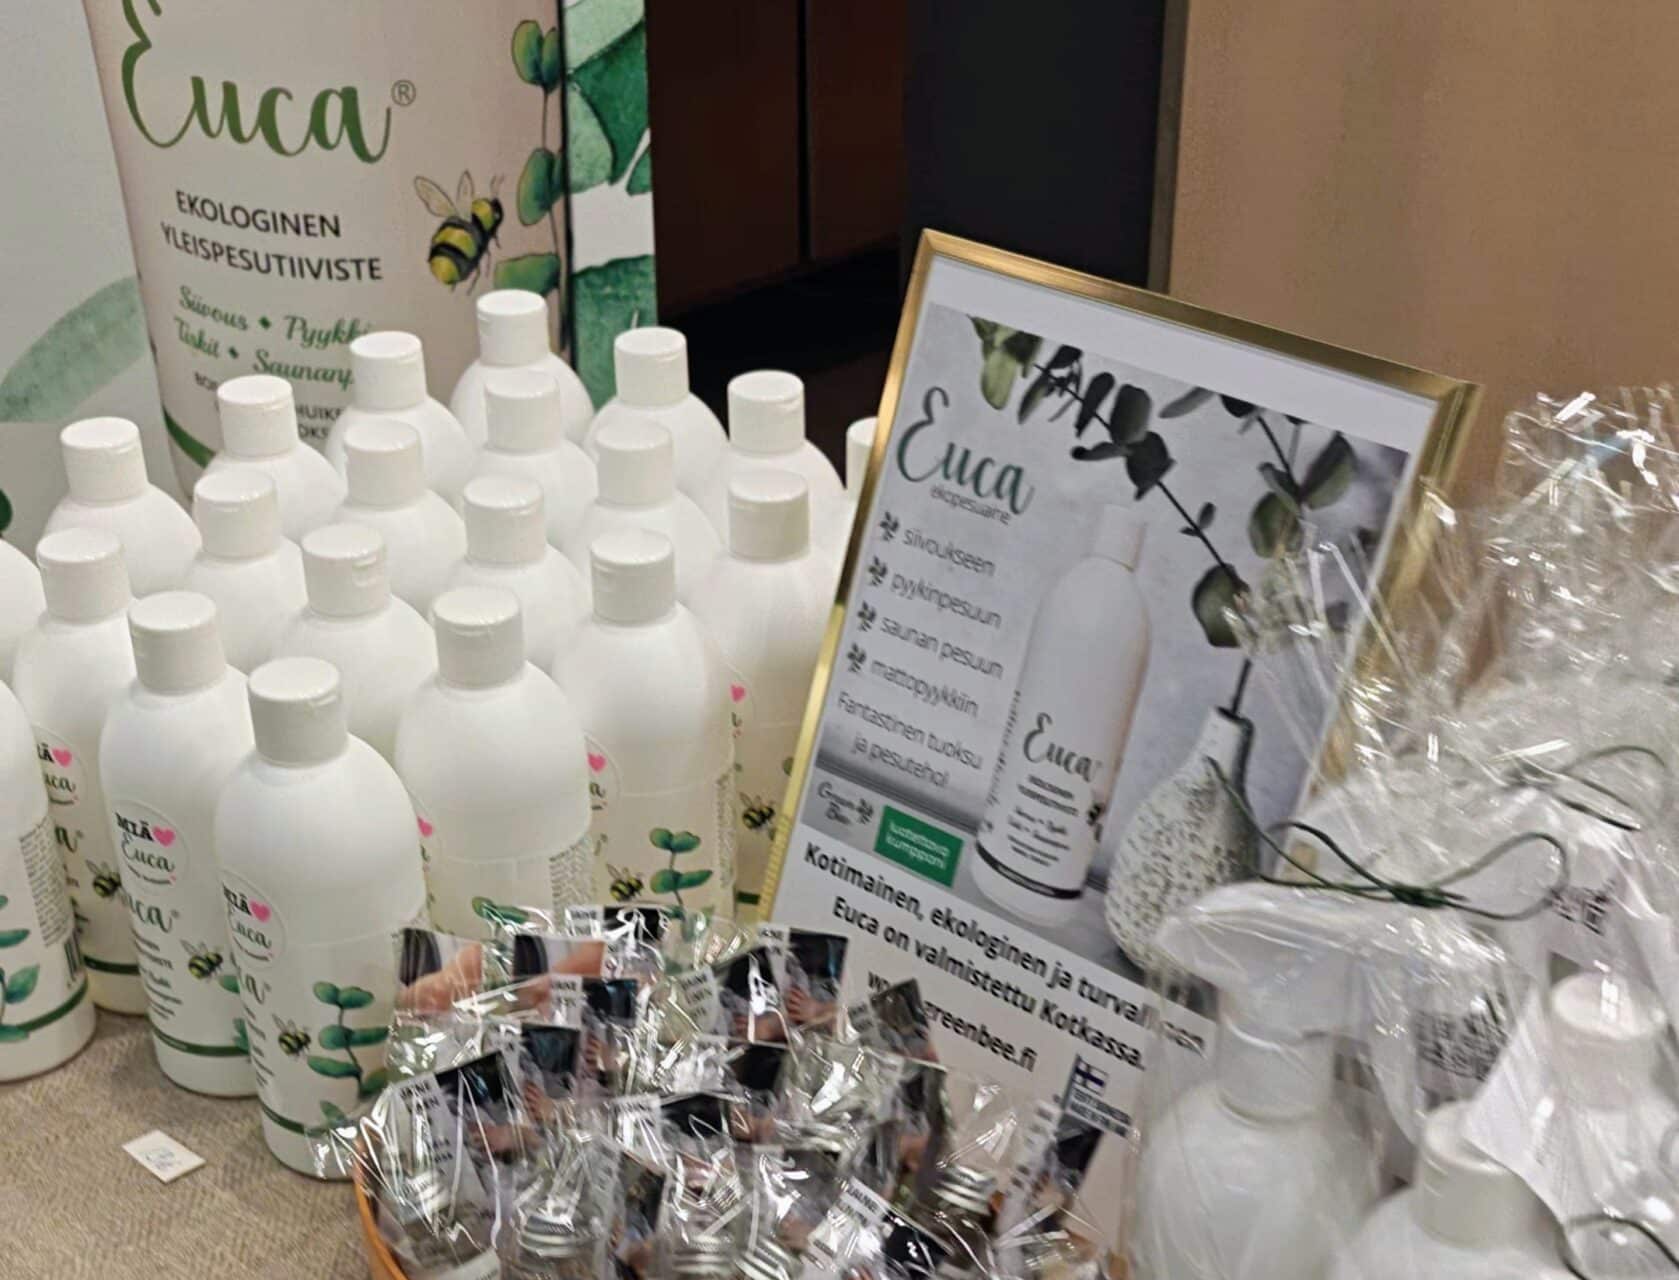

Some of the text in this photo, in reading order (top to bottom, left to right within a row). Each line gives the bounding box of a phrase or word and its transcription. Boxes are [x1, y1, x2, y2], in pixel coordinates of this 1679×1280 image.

[175, 190, 341, 238] EKOLOGINEN
[160, 221, 383, 282] YLEISPESUTIIVISTE
[178, 284, 249, 331] Siivous
[896, 385, 1035, 516] Euca
[903, 528, 995, 578] siivoukseen
[891, 572, 1002, 630] pyykinpesuun
[880, 616, 1004, 681] saunan pesuun
[870, 659, 979, 718] mattopyykkiin
[838, 690, 925, 745] Fantastinen
[927, 732, 983, 771] tuoksu
[853, 732, 868, 756] ja
[121, 831, 176, 873] Euca
[803, 840, 925, 924] Kotimainen,
[929, 907, 1048, 985] ekologinen
[1050, 960, 1074, 993] ja
[832, 895, 1148, 1072] Euca on valmistettu Kotkassa.
